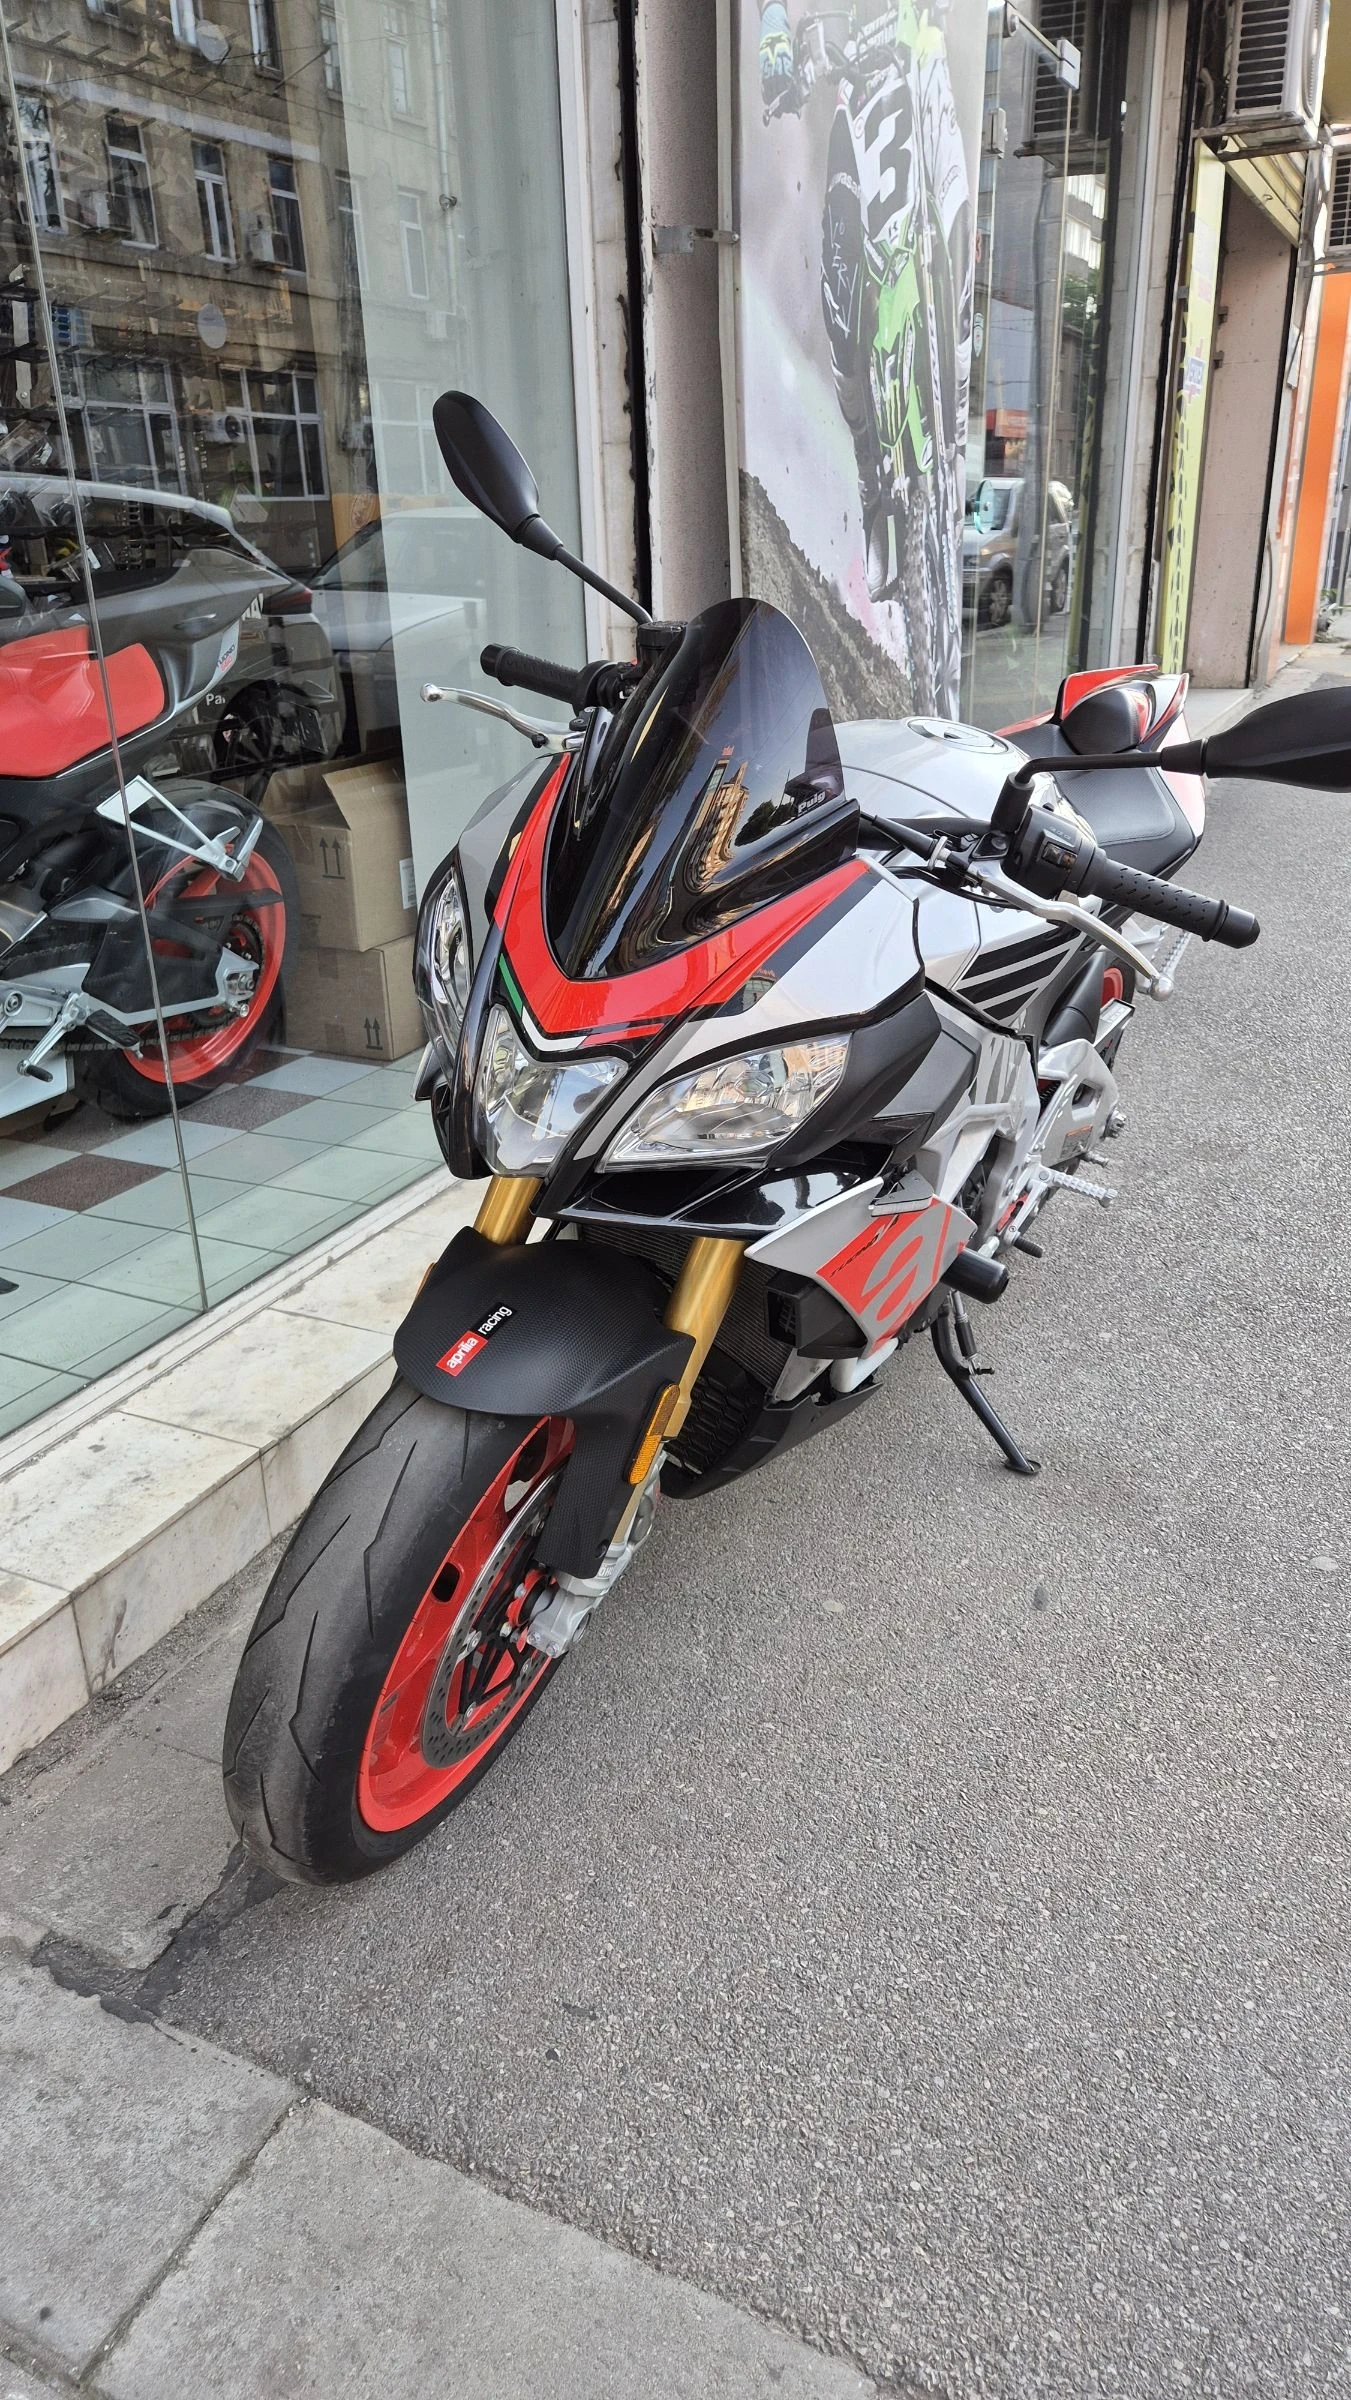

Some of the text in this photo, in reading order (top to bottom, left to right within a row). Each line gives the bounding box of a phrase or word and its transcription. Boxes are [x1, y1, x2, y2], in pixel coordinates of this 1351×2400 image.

[798, 791, 826, 814] Puig
[446, 1306, 513, 1368] aprilia racing
